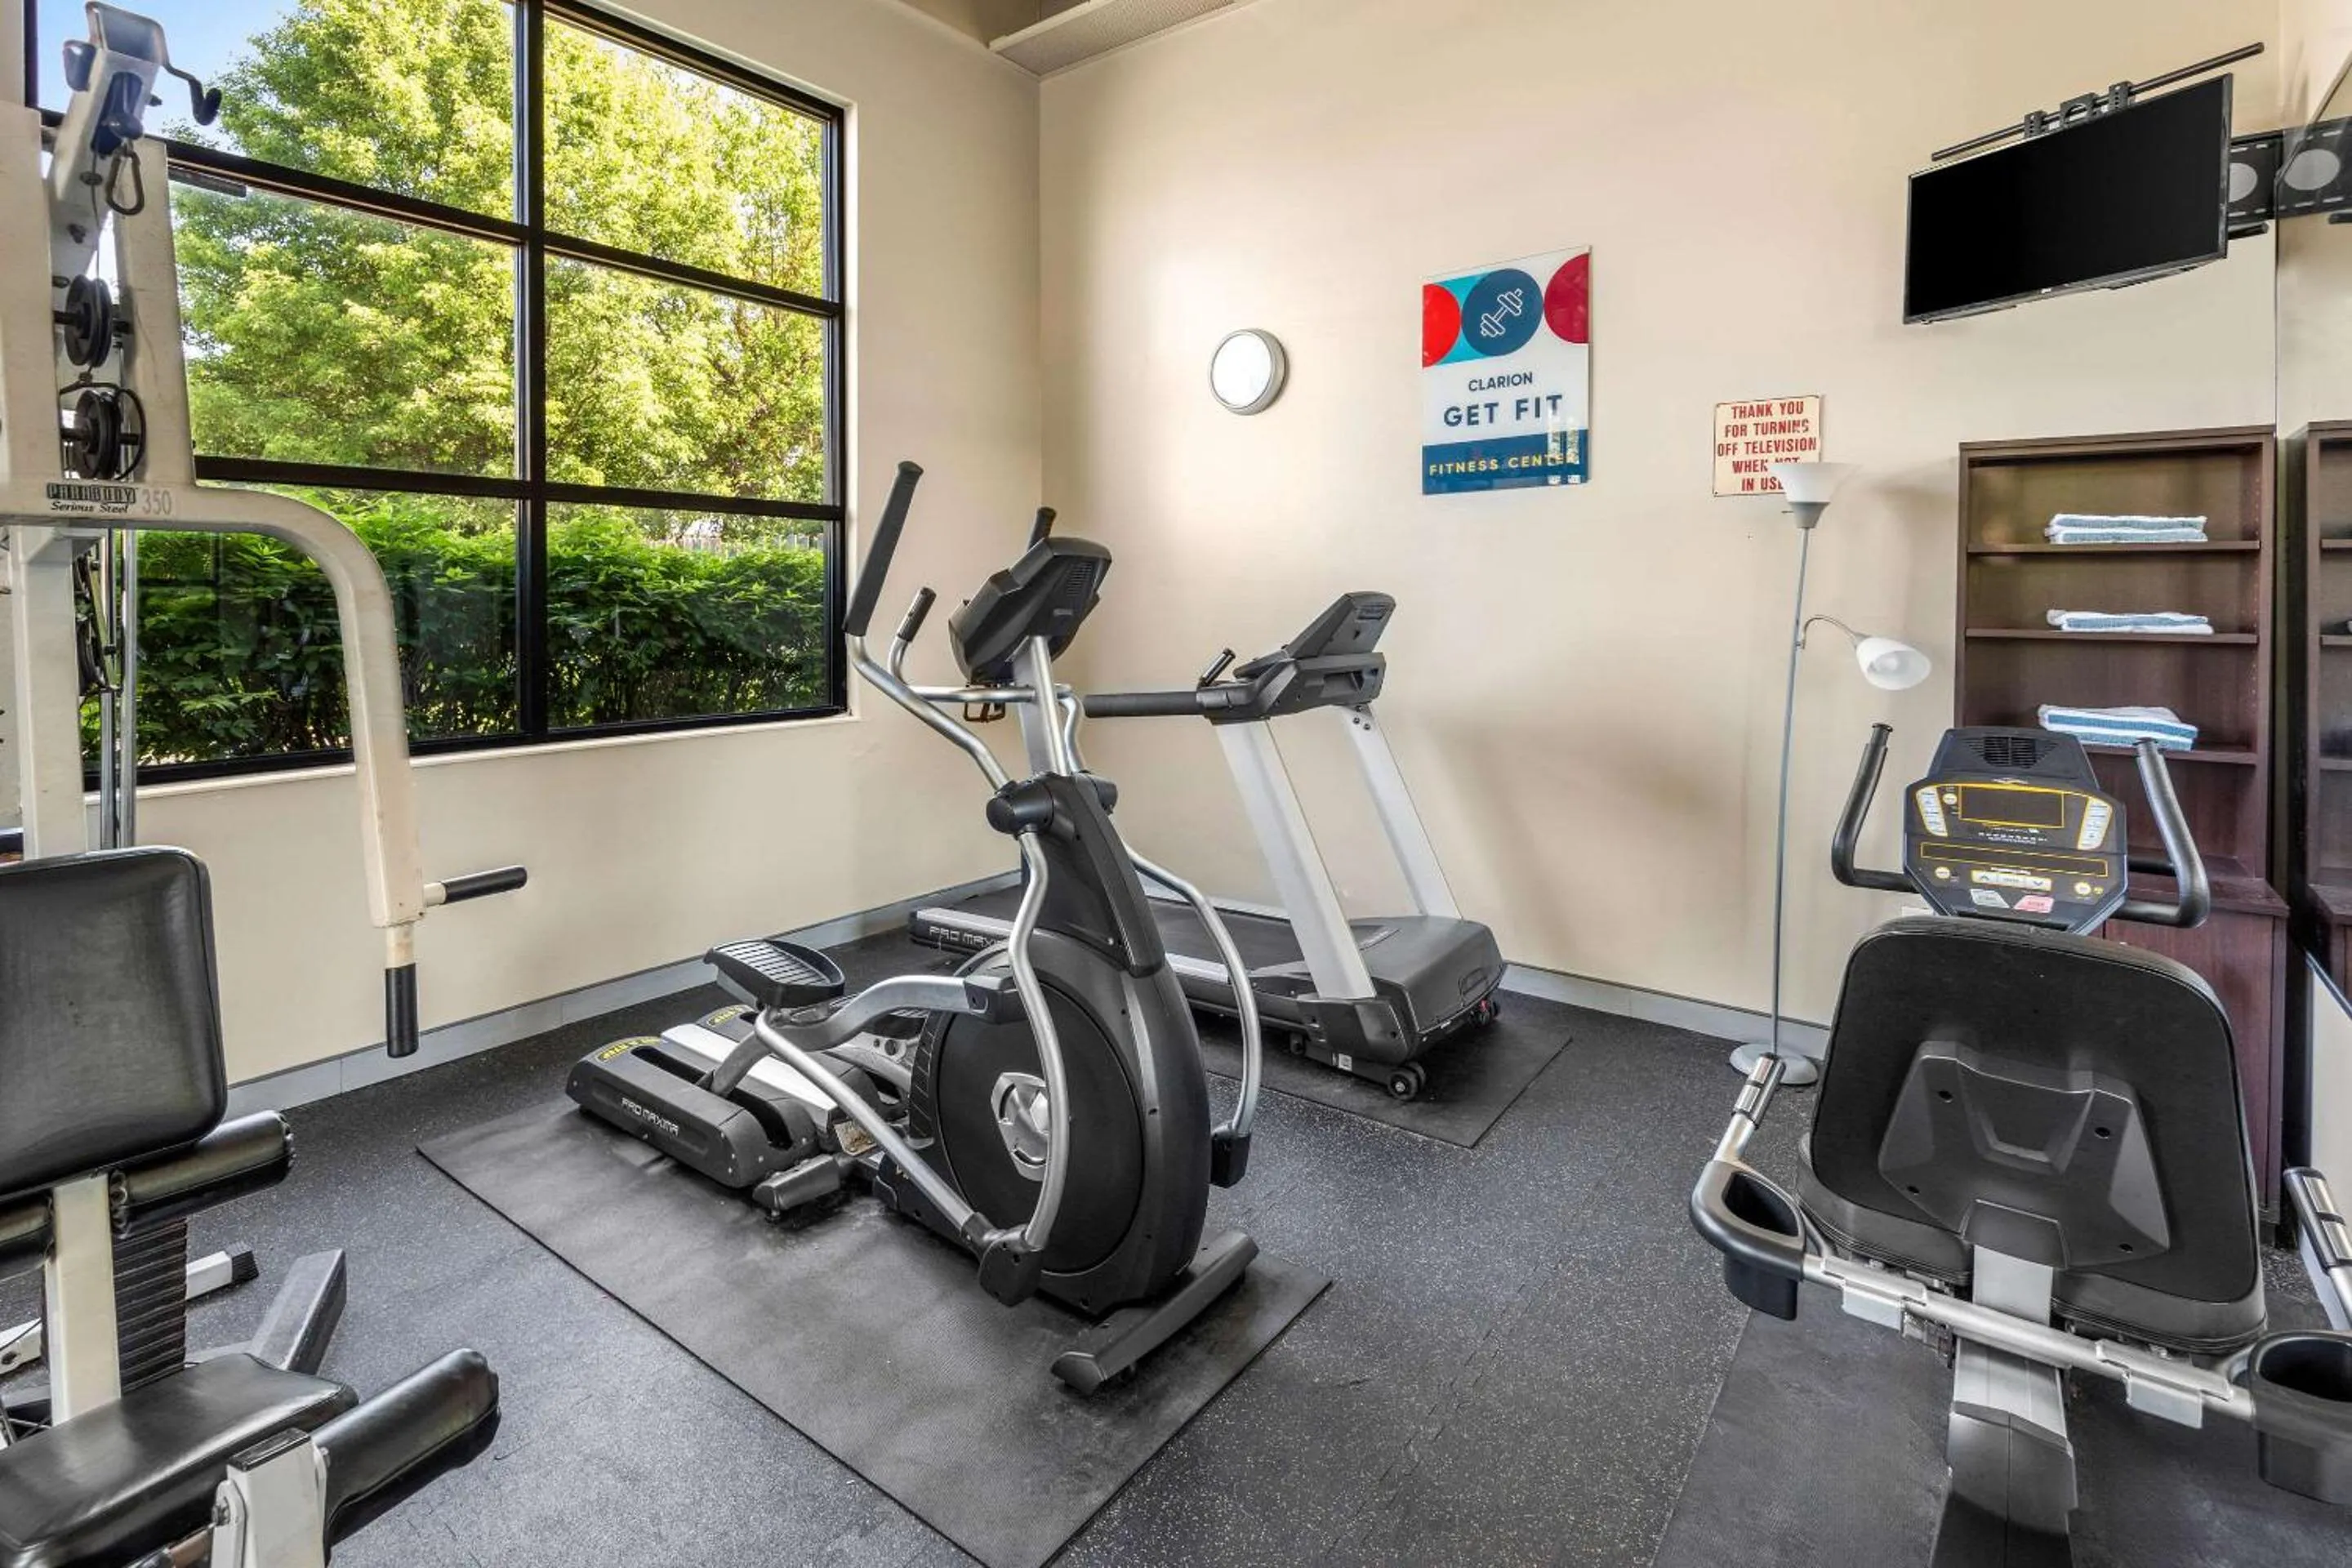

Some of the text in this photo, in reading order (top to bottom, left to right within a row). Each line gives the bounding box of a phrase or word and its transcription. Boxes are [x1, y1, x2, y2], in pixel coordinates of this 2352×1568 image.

[1468, 372, 1533, 392] CLARION
[1443, 394, 1562, 426] GET FIT
[1731, 401, 1804, 419] THANK YOU
[1725, 424, 1748, 438] FOR
[1717, 437, 1816, 457] OFF TELEVISION
[1429, 452, 1579, 476] FITNESS CENTER
[1741, 478, 1754, 491] IN
[50, 501, 129, 514] Serious Steel
[142, 489, 172, 515] 350
[929, 926, 960, 941] PRO
[621, 1097, 679, 1137] PRO MAXIMA
